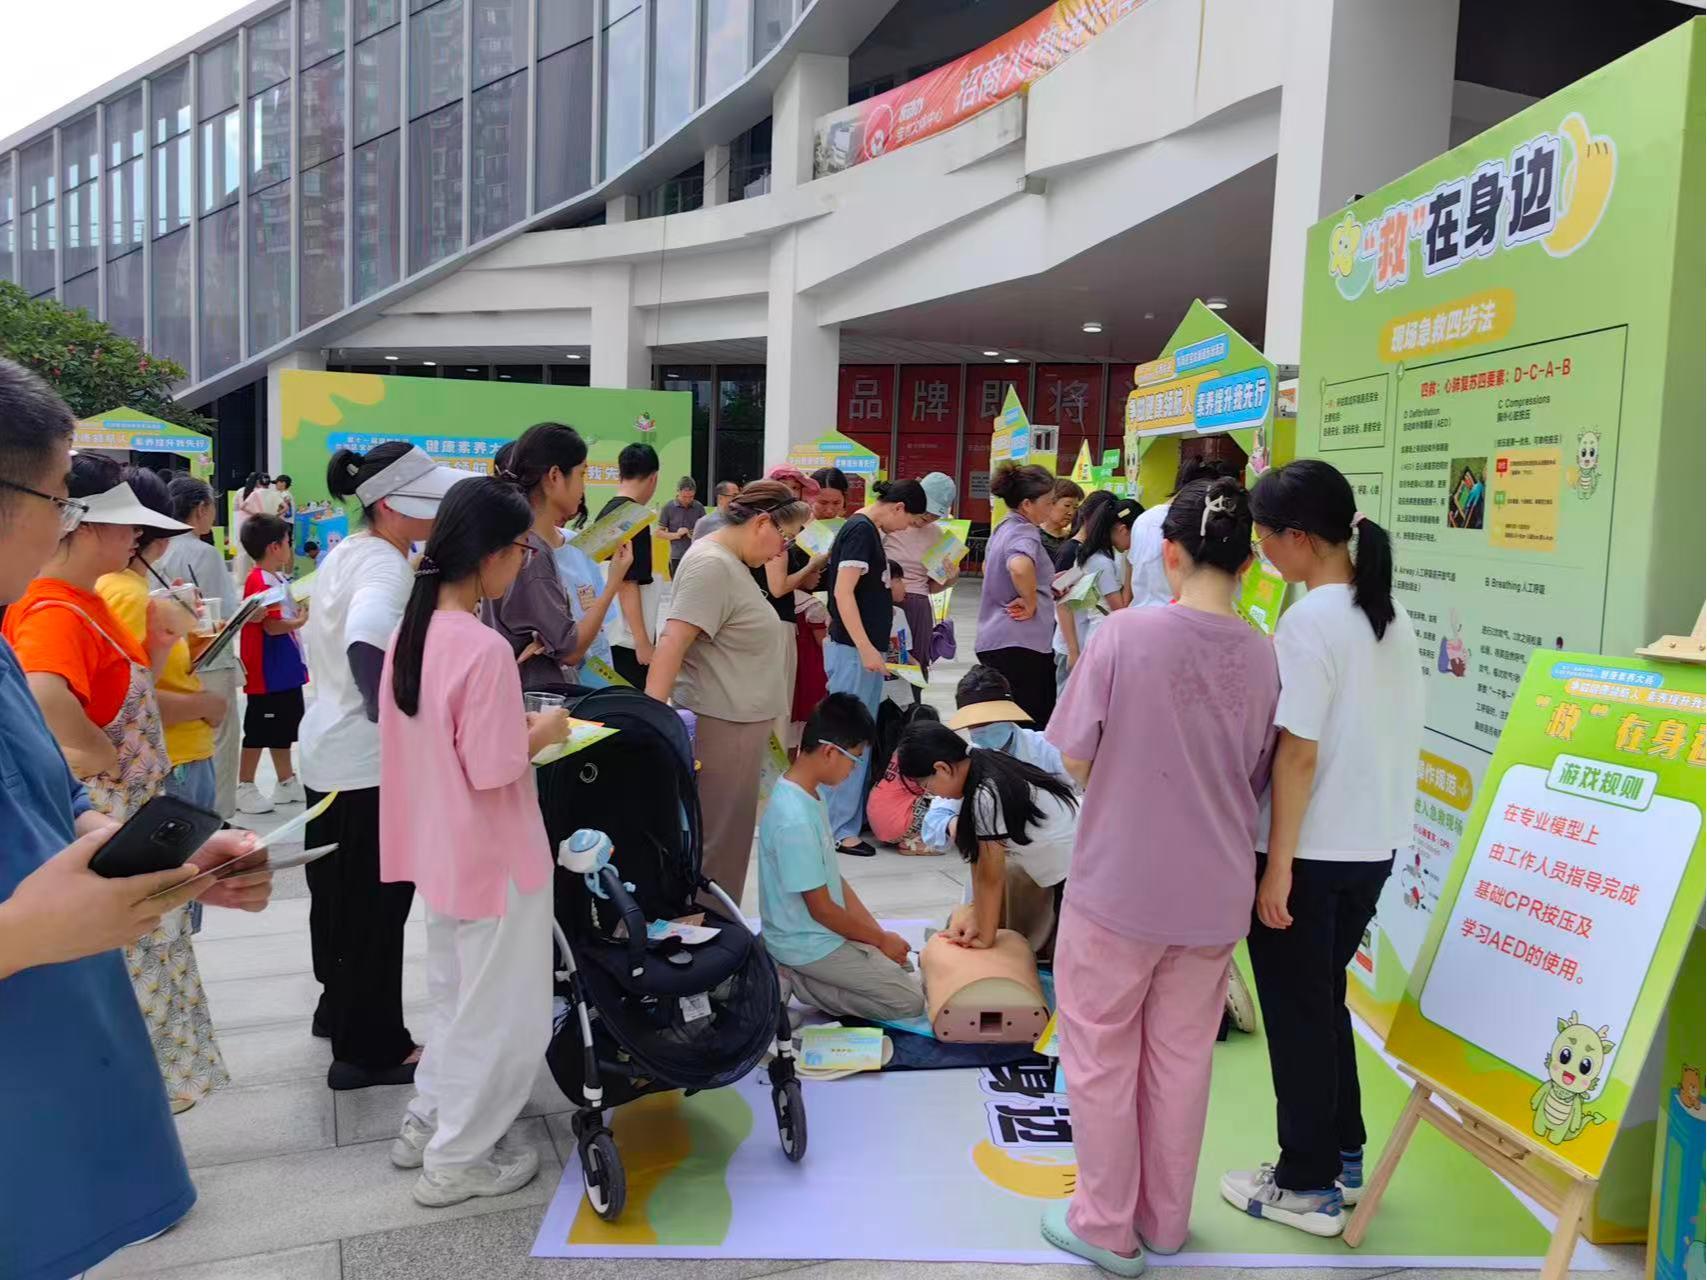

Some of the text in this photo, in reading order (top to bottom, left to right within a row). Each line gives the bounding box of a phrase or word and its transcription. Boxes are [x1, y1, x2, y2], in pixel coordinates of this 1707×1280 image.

[1362, 146, 1555, 283] “救”在身边
[1391, 299, 1497, 353] 现场急救四步法
[1491, 578, 1522, 594] Breathing
[1558, 762, 1645, 802] 游戏规则
[1503, 803, 1600, 846] 在专业模型上
[1488, 842, 1640, 906] 由工作人员指导完成
[1474, 879, 1593, 940] 基础CPR按压及
[1461, 917, 1584, 986] 学习AED的使用。
